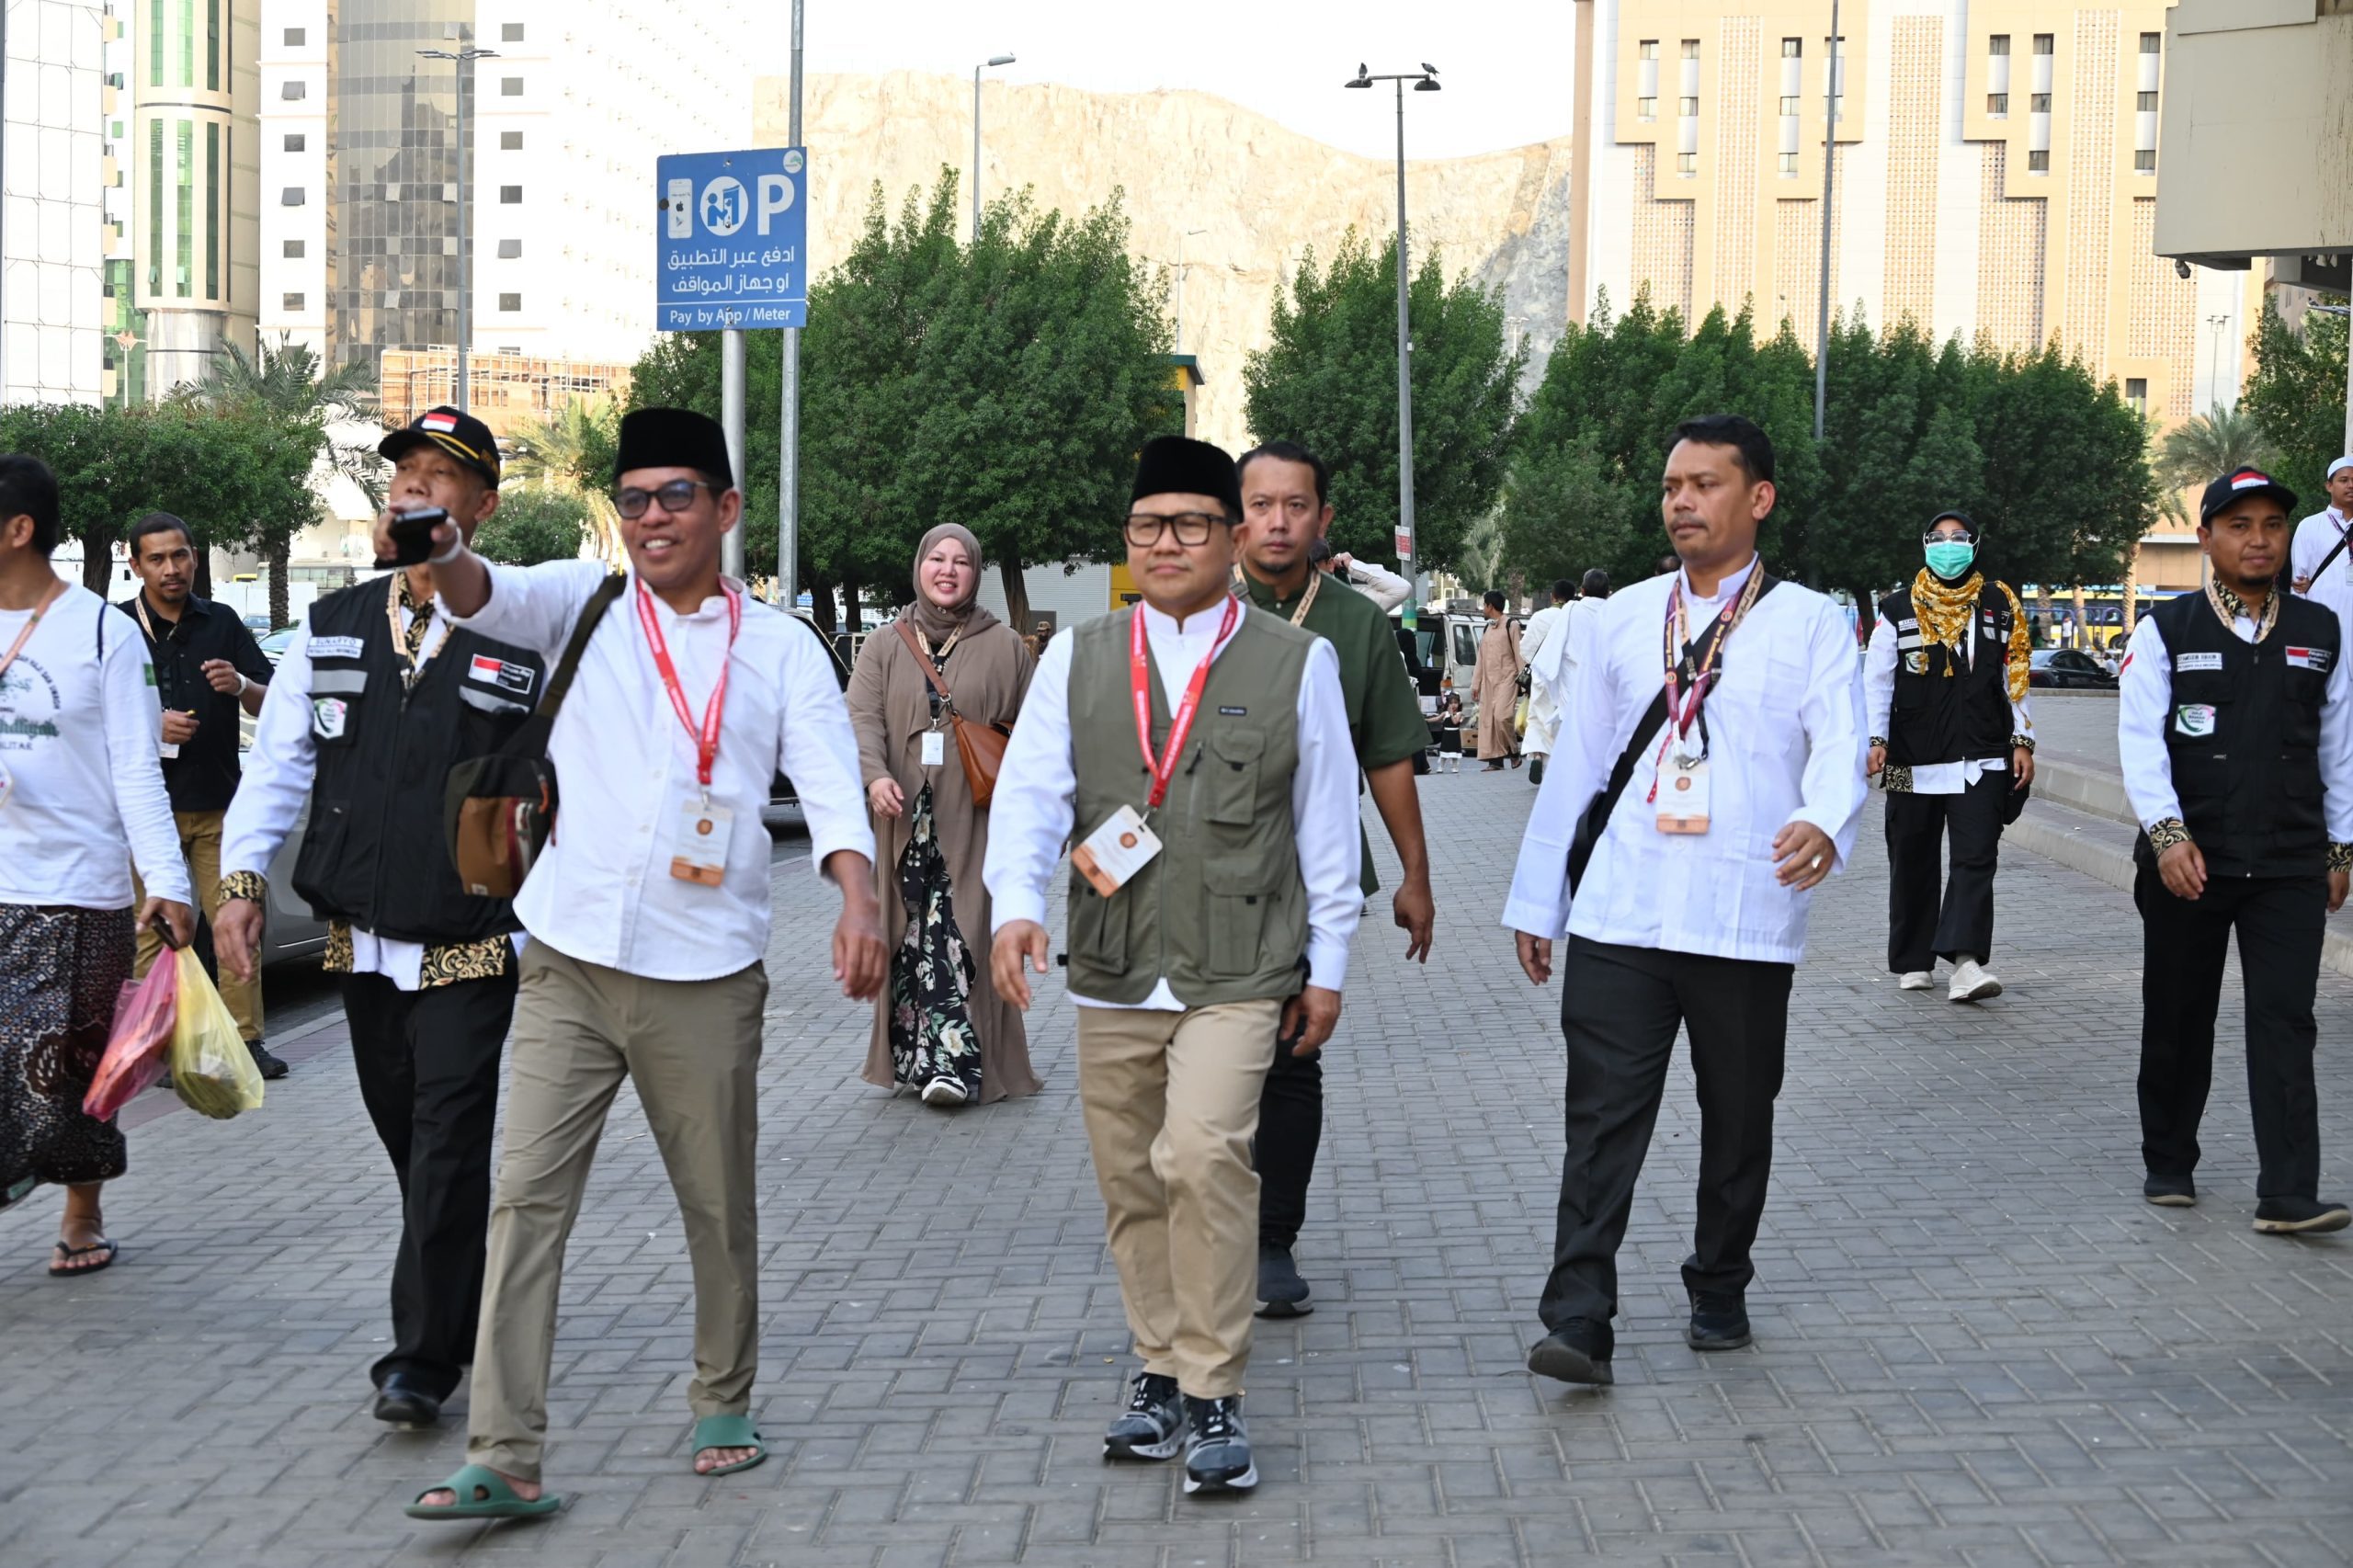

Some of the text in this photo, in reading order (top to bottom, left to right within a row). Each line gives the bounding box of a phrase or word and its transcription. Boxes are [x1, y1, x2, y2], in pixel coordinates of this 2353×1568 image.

[757, 174, 795, 235] P
[667, 245, 795, 271] ادفع عبر التطبيق
[672, 273, 790, 295] او جهاز المواقف
[670, 310, 692, 325] Pay
[698, 309, 713, 325] by
[716, 309, 743, 325] App
[753, 308, 791, 321] Meter
